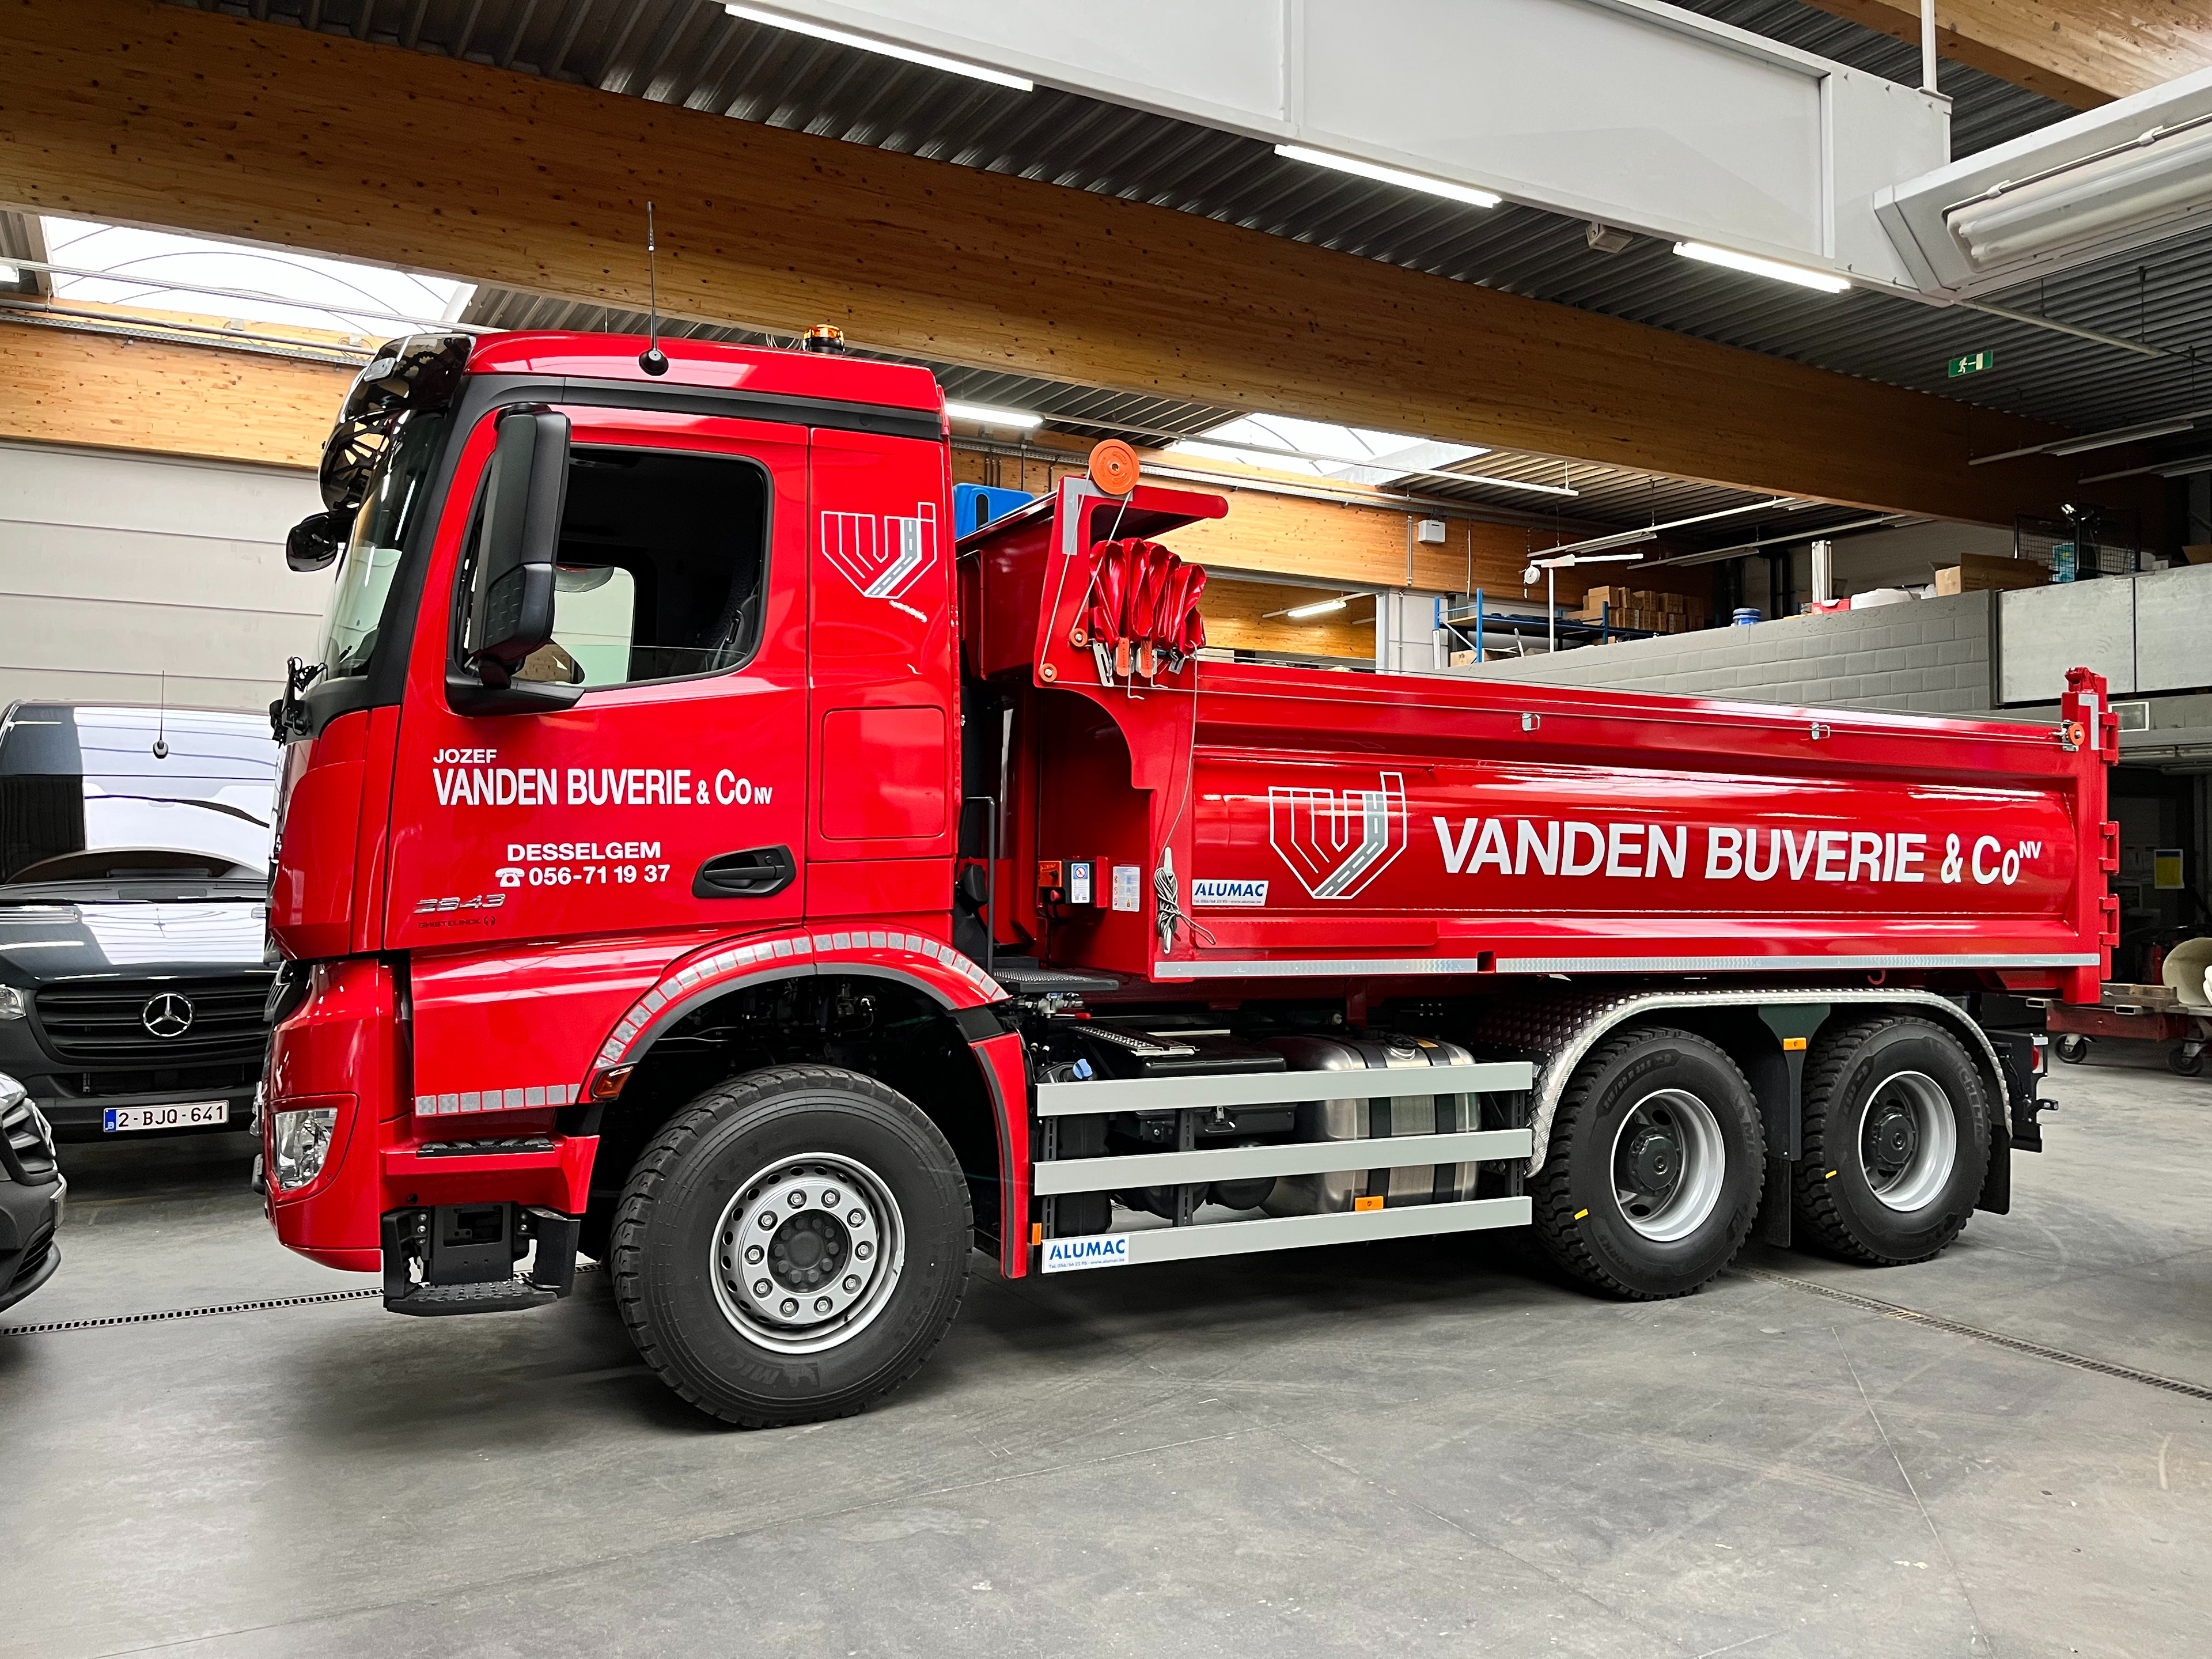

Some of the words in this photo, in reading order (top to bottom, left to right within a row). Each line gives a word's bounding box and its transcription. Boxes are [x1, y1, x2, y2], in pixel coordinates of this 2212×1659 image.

[433, 749, 497, 764] JOZEF
[433, 768, 558, 805] VANDEN
[567, 768, 691, 805] BUVERIE
[696, 780, 710, 805] &
[754, 787, 772, 805] NV
[507, 842, 661, 862] DESSELGEM
[1433, 816, 1687, 878] VANDEN
[1705, 827, 1927, 882] BUVERIE
[1940, 833, 1963, 884] &
[2019, 841, 2042, 859] NV
[529, 866, 607, 886] 056-71
[614, 865, 637, 884] 19
[643, 865, 671, 882] 37
[1194, 883, 1264, 896] ALUMAC
[418, 918, 480, 929] GHISTELINCK
[118, 1105, 223, 1127] 2-BJQ-641
[1049, 1239, 1125, 1260] ALUMAC
